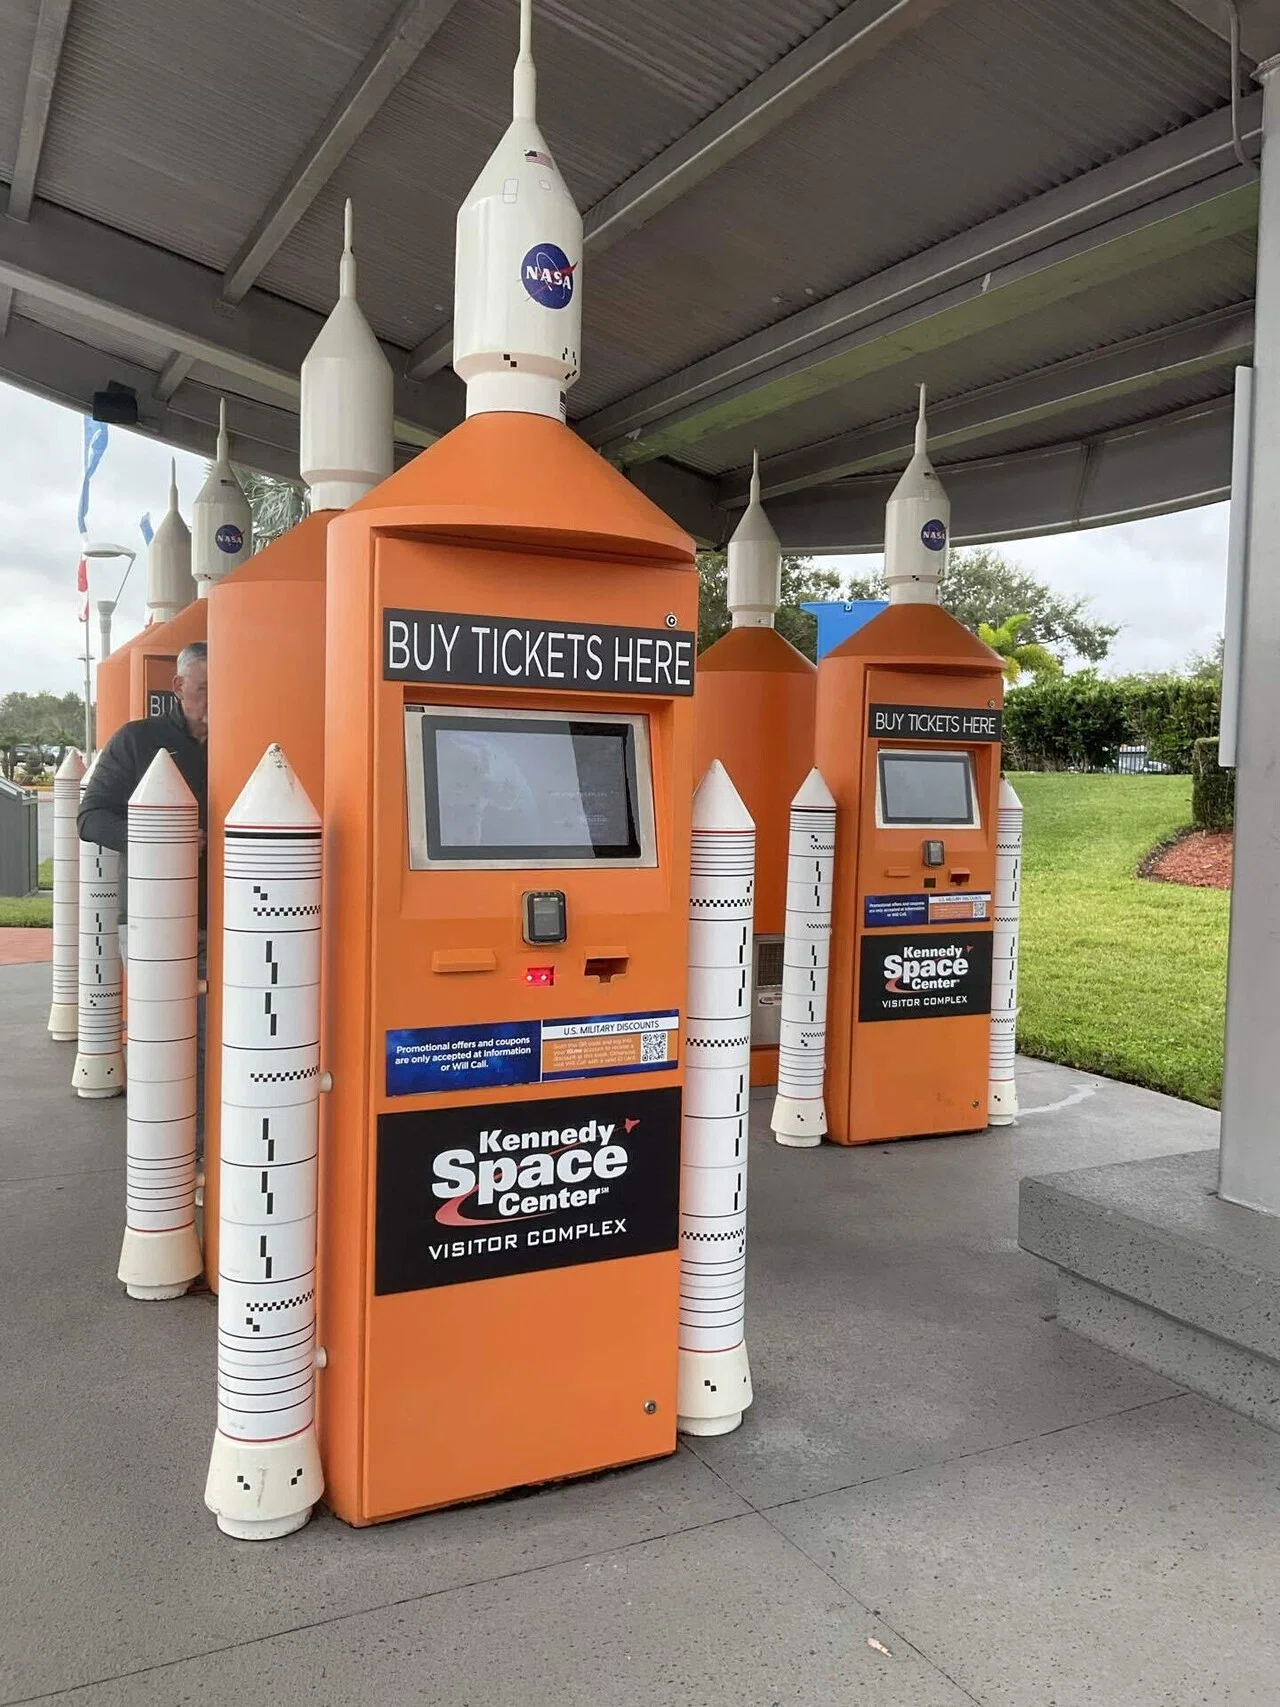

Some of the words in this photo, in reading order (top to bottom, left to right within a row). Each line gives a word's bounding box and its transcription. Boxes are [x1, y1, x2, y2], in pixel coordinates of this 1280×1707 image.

[526, 265, 571, 290] NASA
[217, 535, 242, 543] NASA
[923, 531, 945, 540] NASA
[389, 621, 460, 672] BUY
[472, 627, 603, 680] TICKETS
[614, 637, 691, 685] HERE
[151, 695, 178, 716] BU
[875, 712, 904, 730] BUY
[908, 714, 960, 732] TICKETS
[963, 716, 996, 734] HERE
[903, 945, 962, 958] Kennedy
[884, 955, 968, 984] Space
[912, 978, 956, 989] Center
[882, 998, 920, 1008] VISITOR
[924, 996, 967, 1005] COMPLEX
[564, 1027, 578, 1035] U.S.
[580, 1024, 615, 1034] MILITARY
[617, 1020, 659, 1031] DISCOUNTS
[396, 1042, 449, 1054] Promotional
[452, 1041, 476, 1050] offers
[478, 1039, 494, 1048] and
[495, 1036, 530, 1047] coupons
[411, 1055, 430, 1064] only
[432, 1051, 471, 1062] accepted
[484, 1047, 531, 1057] Information
[452, 1062, 468, 1070] Will
[471, 1060, 488, 1068] Call.
[479, 1120, 615, 1154] Kennedy
[432, 1145, 628, 1205] Space
[498, 1188, 601, 1216] Center
[429, 1234, 517, 1260] VISITOR
[527, 1218, 627, 1246] COMPLEX
